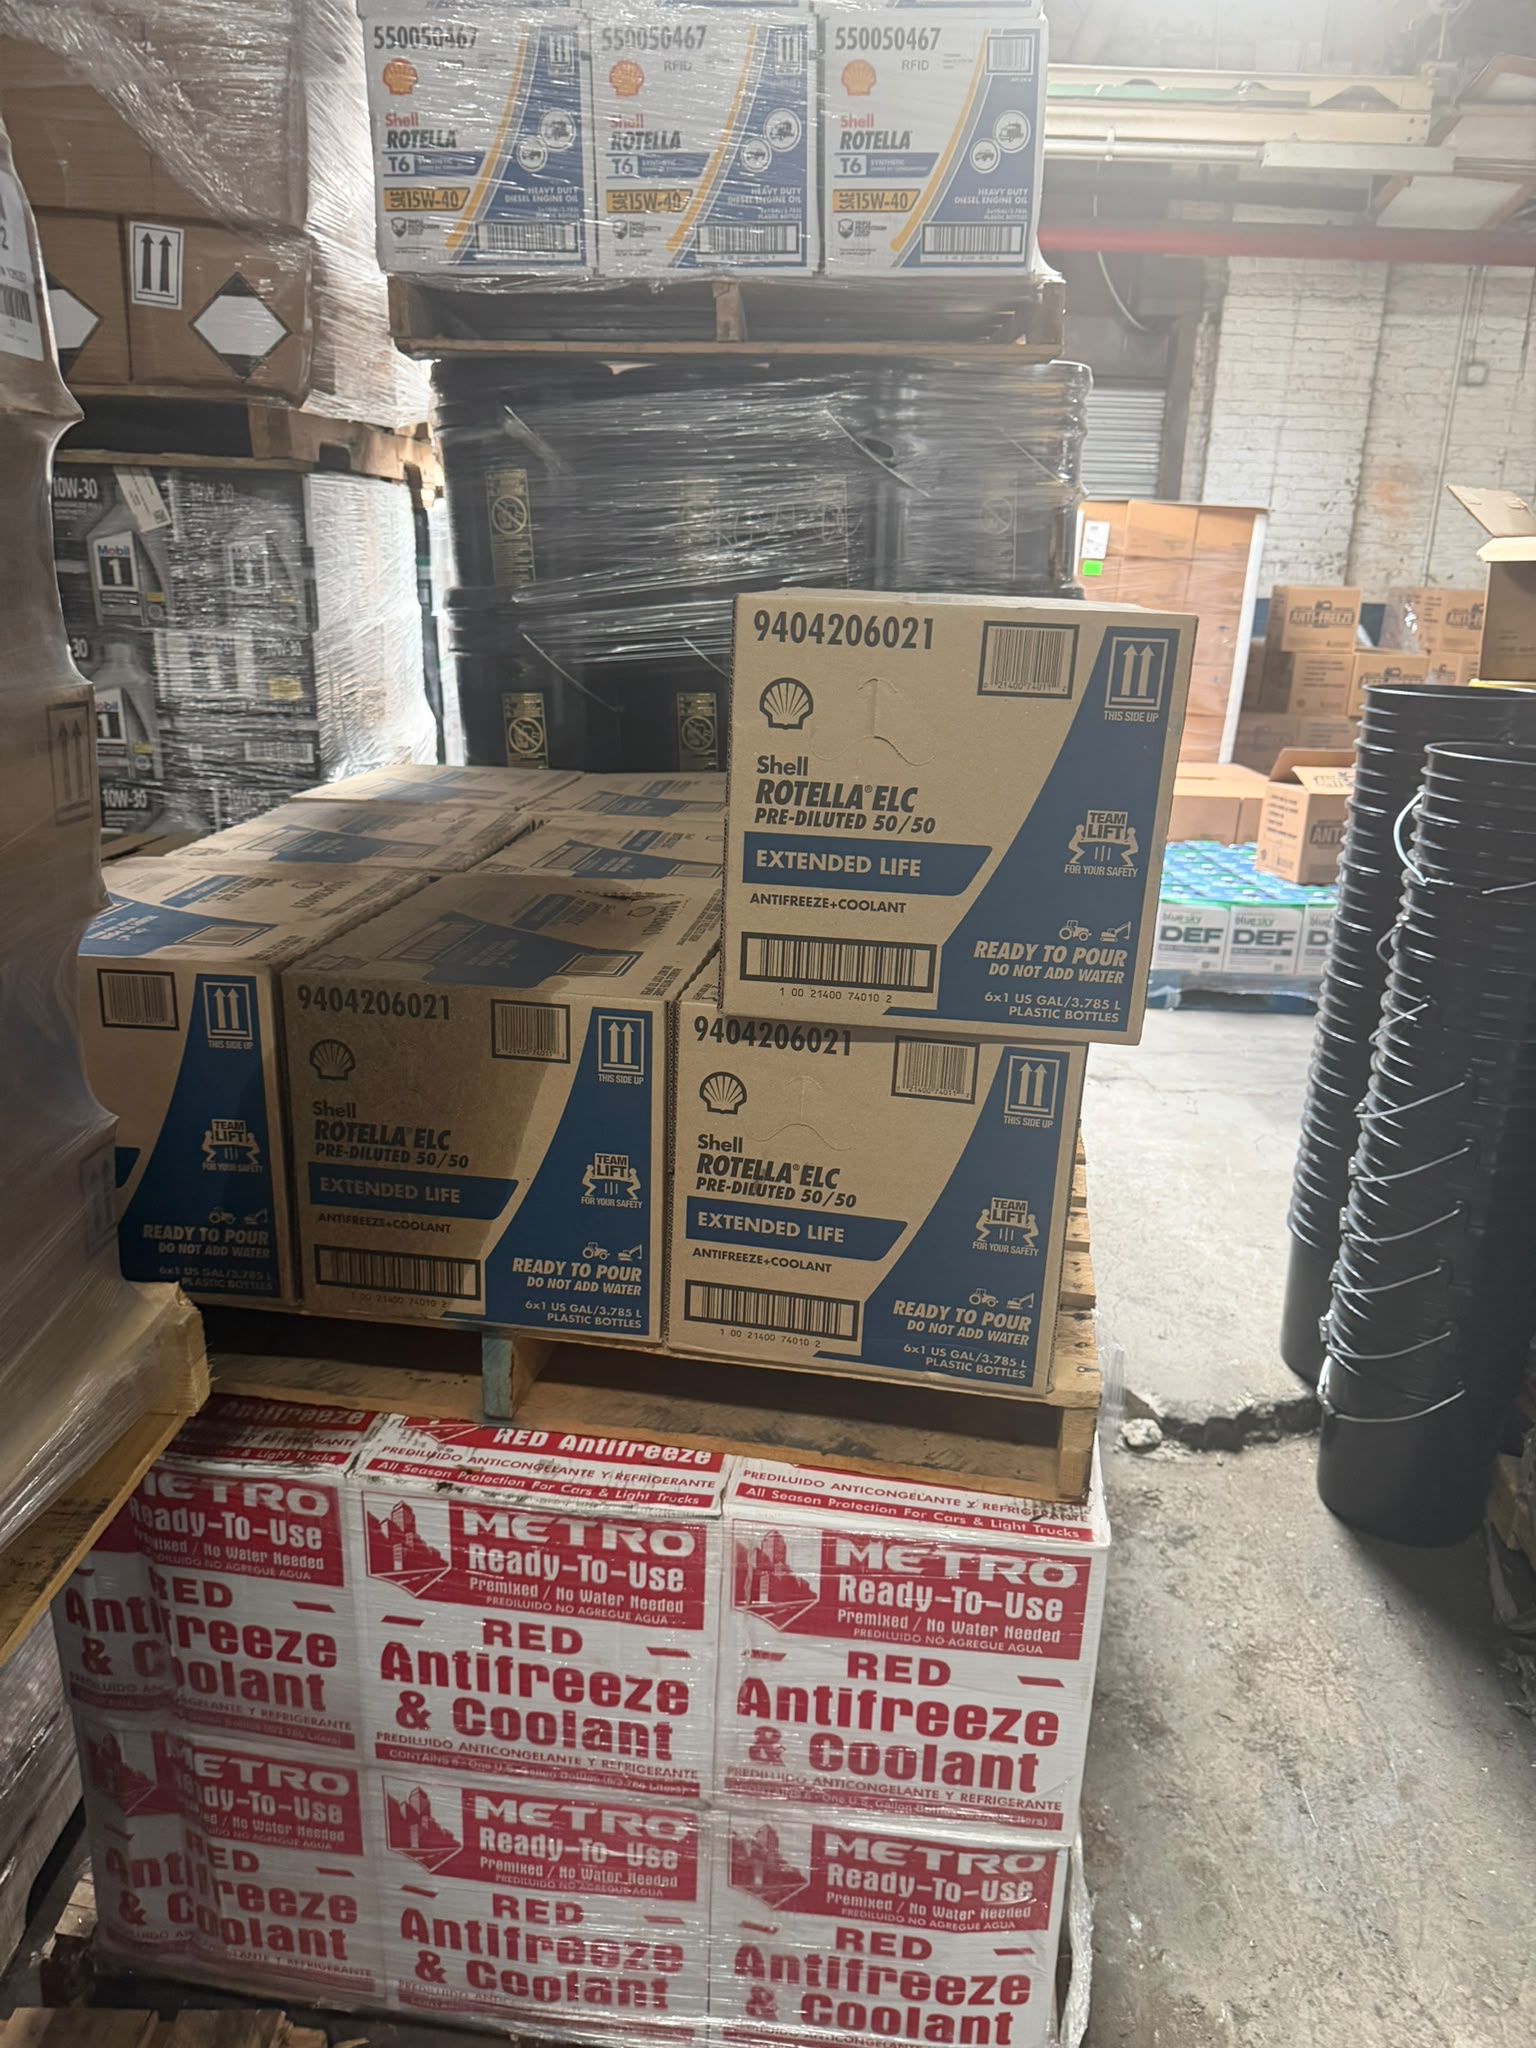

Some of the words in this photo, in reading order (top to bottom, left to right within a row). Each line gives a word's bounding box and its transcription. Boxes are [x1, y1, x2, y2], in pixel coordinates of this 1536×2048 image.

[601, 26, 708, 50] 550050467
[834, 27, 941, 50] 550050467
[902, 60, 929, 71] RFID
[385, 112, 419, 127] Shell
[840, 113, 874, 128] Shell
[388, 156, 410, 172] T6
[612, 158, 633, 174] T6
[840, 158, 862, 173] T6
[406, 191, 459, 208] 15W-40
[629, 191, 682, 210] 15W-40
[856, 192, 909, 209] 15W-40
[978, 188, 1005, 196] HEAVY
[1007, 188, 1029, 196] DUTY
[53, 478, 98, 500] 10W-30
[108, 559, 123, 585] 1
[753, 610, 933, 650] 9404206021
[1104, 711, 1123, 721] THIS
[1125, 711, 1145, 722] SIDE
[1146, 712, 1159, 722] UP
[756, 755, 808, 776] Shell
[102, 789, 148, 809] 10W-30
[872, 785, 919, 813] ELC
[754, 807, 867, 830] PRE-DILUTED
[873, 815, 936, 834] 50/50
[1089, 812, 1126, 824] TEAM
[1087, 824, 1125, 839] LIFT
[756, 849, 872, 874] EXTENDED
[880, 856, 921, 877] LIFE
[1064, 864, 1081, 874] FOR
[1083, 865, 1104, 876] YOUR
[1106, 867, 1139, 878] SAFETY
[749, 892, 907, 913] ANTIFREEZE+COOLANT
[1160, 926, 1224, 943] DEF
[1232, 929, 1296, 946] DEF
[973, 940, 1039, 962] READY
[1043, 944, 1068, 963] TO
[1072, 947, 1128, 967] POUR
[989, 963, 1009, 976] DO
[1012, 965, 1043, 979] NOT
[1044, 967, 1074, 981] ADD
[1078, 968, 1125, 984] WATER
[297, 984, 450, 1020] 9404206021
[780, 987, 785, 996] 1
[791, 988, 804, 997] 00
[810, 989, 842, 1000] 21400
[848, 992, 879, 1002] 74010
[886, 994, 892, 1003] 2
[984, 991, 1009, 1003] 6x1
[1015, 993, 1032, 1004] US
[1036, 995, 1110, 1010] GAL/3.785
[1114, 1000, 1121, 1011] L
[1008, 1006, 1060, 1019] PLASTIC
[1064, 1010, 1119, 1023] BOTTLES
[694, 1015, 851, 1056] 9404206021
[313, 1101, 356, 1118] Shell
[414, 1128, 451, 1151] ELC
[698, 1134, 743, 1153] Shell
[315, 1142, 410, 1164] PRE-DILUTED
[416, 1152, 469, 1168] 50/50
[320, 1177, 418, 1200] EXTENDED
[425, 1186, 461, 1203] LIFE
[800, 1165, 841, 1190] ELC
[696, 1177, 796, 1201] PRE-DILUTED
[800, 1189, 857, 1209] 50/50
[994, 1200, 1026, 1211] TEAM
[318, 1213, 452, 1234] ANTIFREEZE+COOLANT
[697, 1211, 801, 1238] EXTENDED
[807, 1224, 845, 1244] LIFE
[992, 1211, 1025, 1223] LIFT
[143, 1224, 195, 1241] READY
[199, 1227, 221, 1243] TO
[224, 1229, 269, 1246] POUR
[512, 1257, 567, 1276] READY
[571, 1262, 592, 1278] TO
[596, 1264, 642, 1282] POUR
[692, 1247, 833, 1273] ANTIFREEZE+COOLANT
[893, 1300, 951, 1321] READY
[955, 1308, 977, 1324] TO
[981, 1311, 1032, 1332] POUR
[926, 1356, 972, 1372] PLASTIC
[976, 1364, 1026, 1380] BOTTLES
[493, 1428, 549, 1448] RED
[558, 1433, 713, 1466] Antifreeze
[382, 1445, 464, 1464] PREDILUIDO
[467, 1454, 596, 1480] ANTICONGELANTE
[600, 1470, 612, 1480] Y
[614, 1471, 716, 1489] REFRIGERANTE
[377, 1460, 399, 1472] All
[402, 1462, 453, 1480] Season
[458, 1469, 527, 1489] Protection
[533, 1480, 555, 1493] For
[560, 1483, 594, 1497] Cars
[598, 1487, 609, 1498] &
[615, 1489, 651, 1503] Light
[656, 1493, 700, 1506] Trucks
[743, 1468, 826, 1489] PREDILUIDO
[830, 1482, 962, 1508] ANTICONGELANTE
[463, 1508, 696, 1557] METRO
[469, 1543, 686, 1593] Ready-To-Use
[835, 1539, 1078, 1589] METRO
[469, 1577, 539, 1598] Premixed
[544, 1587, 551, 1598] /
[556, 1587, 575, 1601] No
[579, 1589, 626, 1608] Water
[629, 1595, 684, 1614] Needed
[838, 1574, 1065, 1623] Ready-To-Use
[486, 1595, 553, 1612] PREDILUIDO
[555, 1604, 575, 1614] NO
[578, 1606, 632, 1622] AGREGUE
[634, 1613, 669, 1626] AGUA
[482, 1617, 584, 1655] RED
[380, 1641, 690, 1716] Antifreeze
[847, 1650, 951, 1687] RED
[736, 1677, 1060, 1747] Antifreeze
[395, 1690, 432, 1731] &
[452, 1696, 673, 1761] Coolant
[748, 1726, 786, 1767] &
[808, 1732, 1039, 1793] Coolant
[474, 1795, 689, 1842] METRO
[824, 1832, 1047, 1875] METRO
[492, 1893, 585, 1926] RED
[401, 1907, 684, 1973] Antifreeze
[836, 1926, 933, 1961] RED
[414, 1950, 447, 1984] &
[466, 1958, 669, 2010] Coolant
[734, 1943, 1032, 2007] Antifreeze
[800, 1992, 1014, 2046] Coolant
